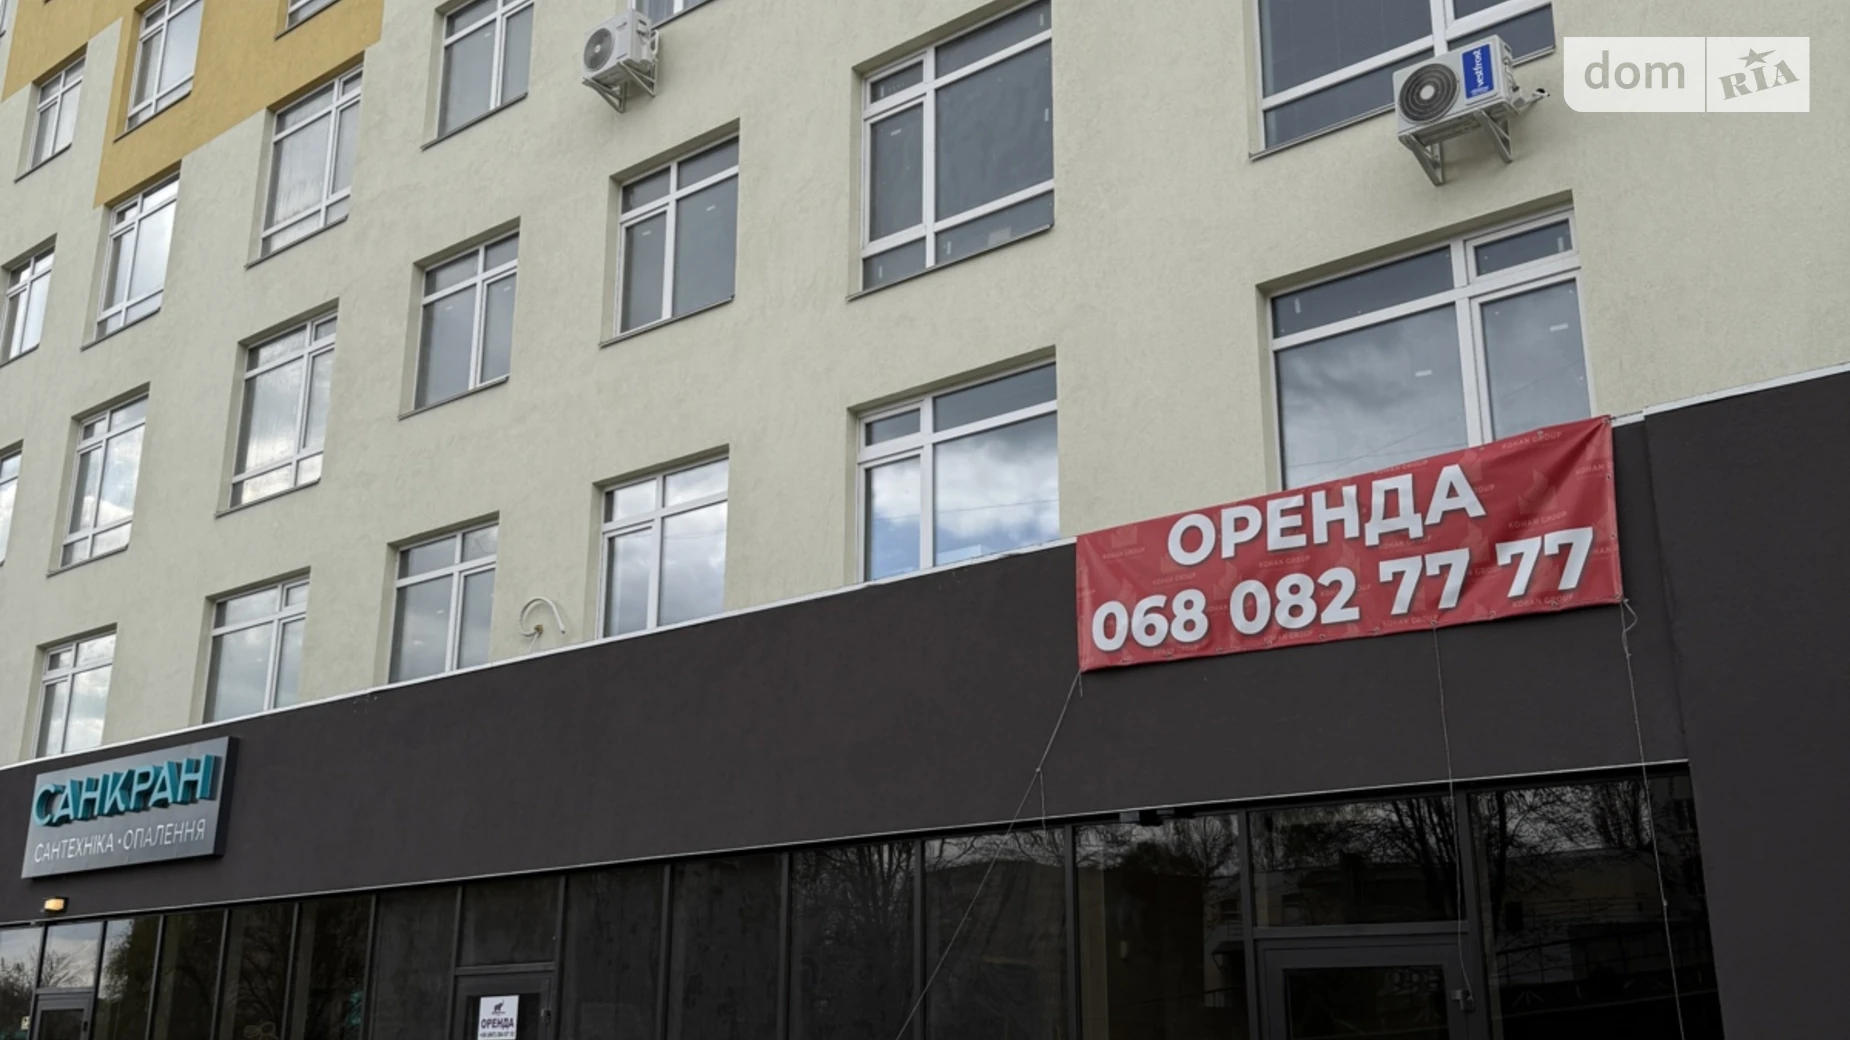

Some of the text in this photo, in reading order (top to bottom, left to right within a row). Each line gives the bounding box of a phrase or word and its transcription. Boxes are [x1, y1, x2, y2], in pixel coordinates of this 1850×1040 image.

[1167, 463, 1486, 566] ОРЕНДА
[1092, 526, 1594, 652] 068 082 77 77
[32, 754, 215, 827] САНКРАН
[34, 819, 206, 863] САНТЕХНІКА ОПАЛЕННЯ
[480, 1018, 514, 1030] ОРЕНДА
